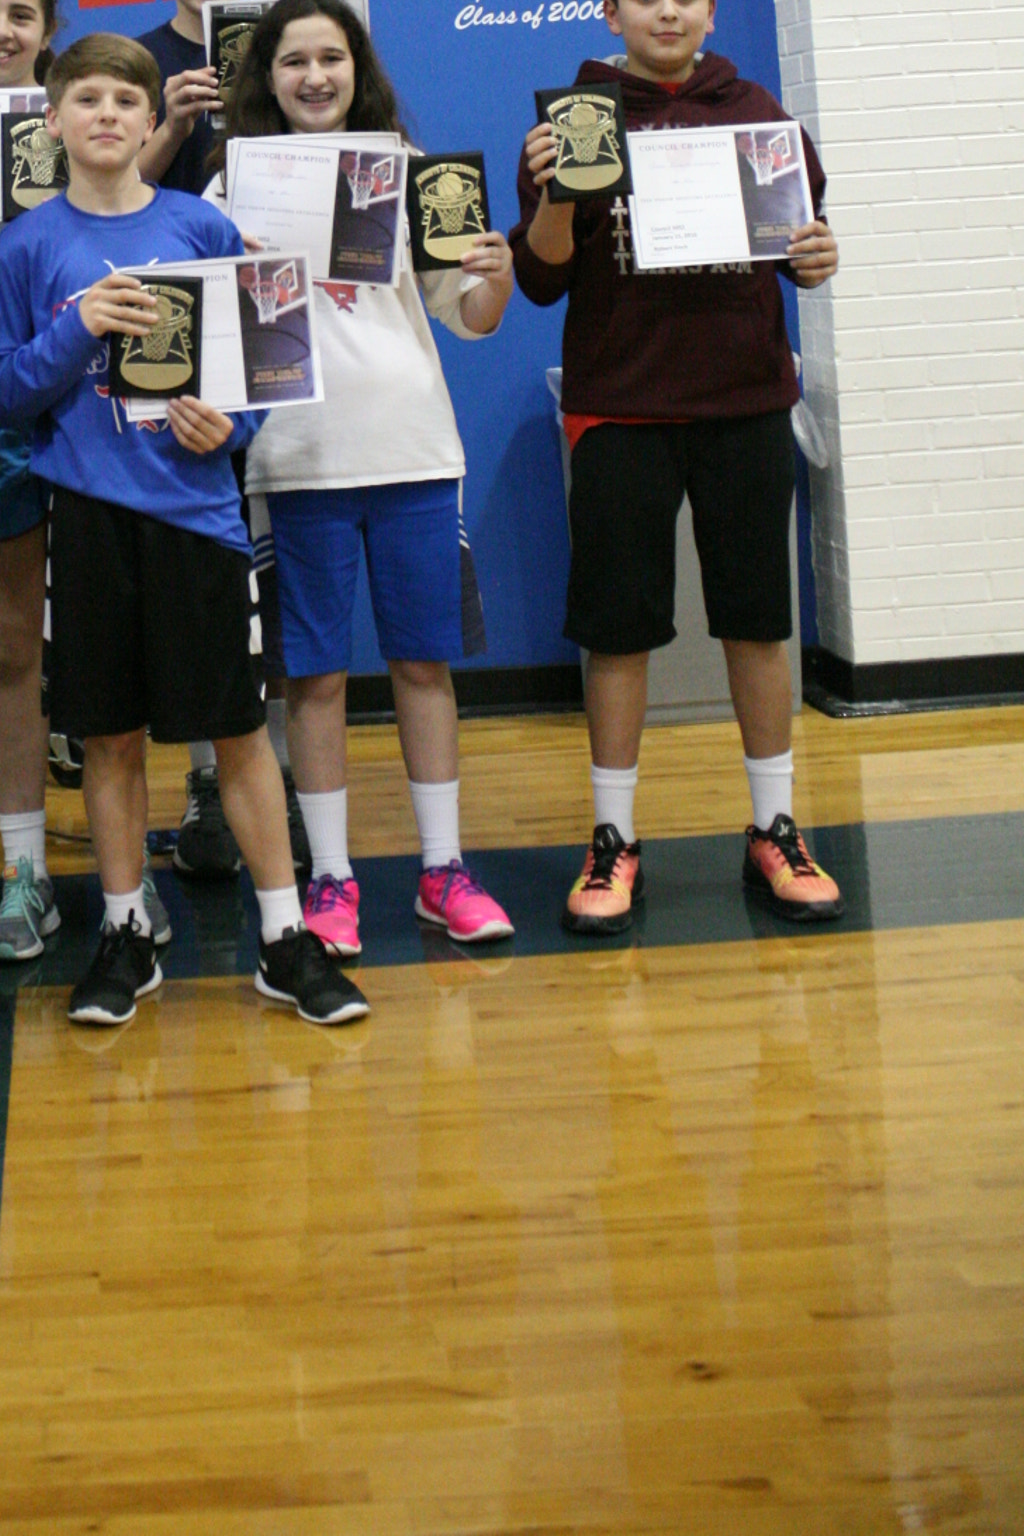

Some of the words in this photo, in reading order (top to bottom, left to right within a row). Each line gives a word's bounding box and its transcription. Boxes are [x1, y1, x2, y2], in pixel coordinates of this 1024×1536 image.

[454, 4, 518, 30] Class
[521, 4, 544, 30] of
[547, 0, 604, 23] 2006
